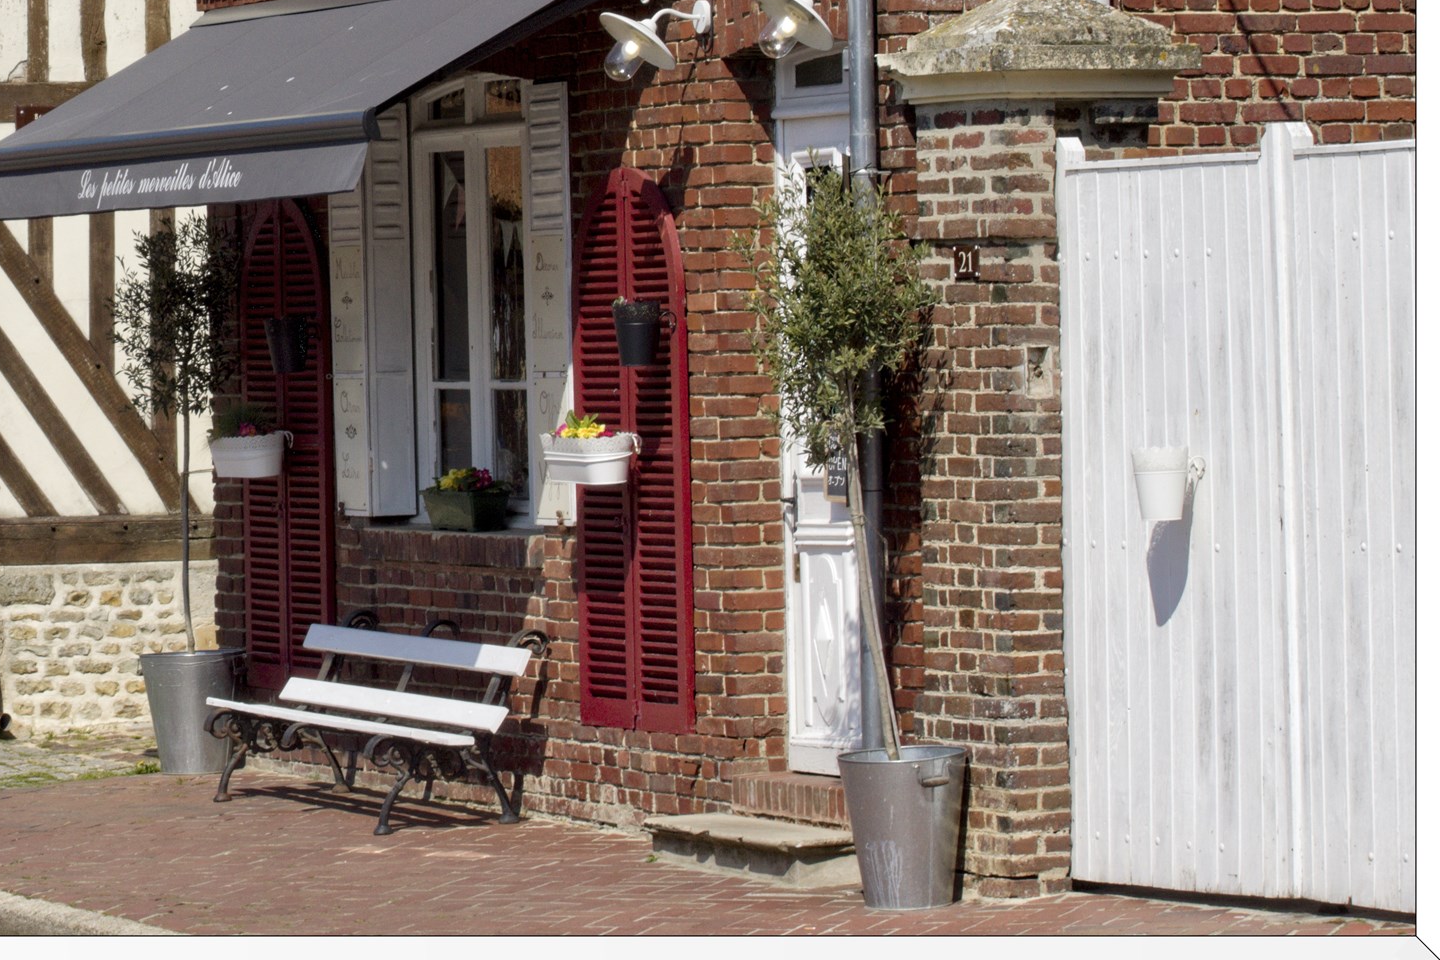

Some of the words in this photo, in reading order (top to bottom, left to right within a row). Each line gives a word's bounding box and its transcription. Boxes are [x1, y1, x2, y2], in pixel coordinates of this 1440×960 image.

[77, 169, 98, 200] Les
[96, 168, 136, 209] petites
[137, 162, 198, 194] merveilles
[199, 157, 243, 190] d'Alice
[958, 251, 973, 273] 21
